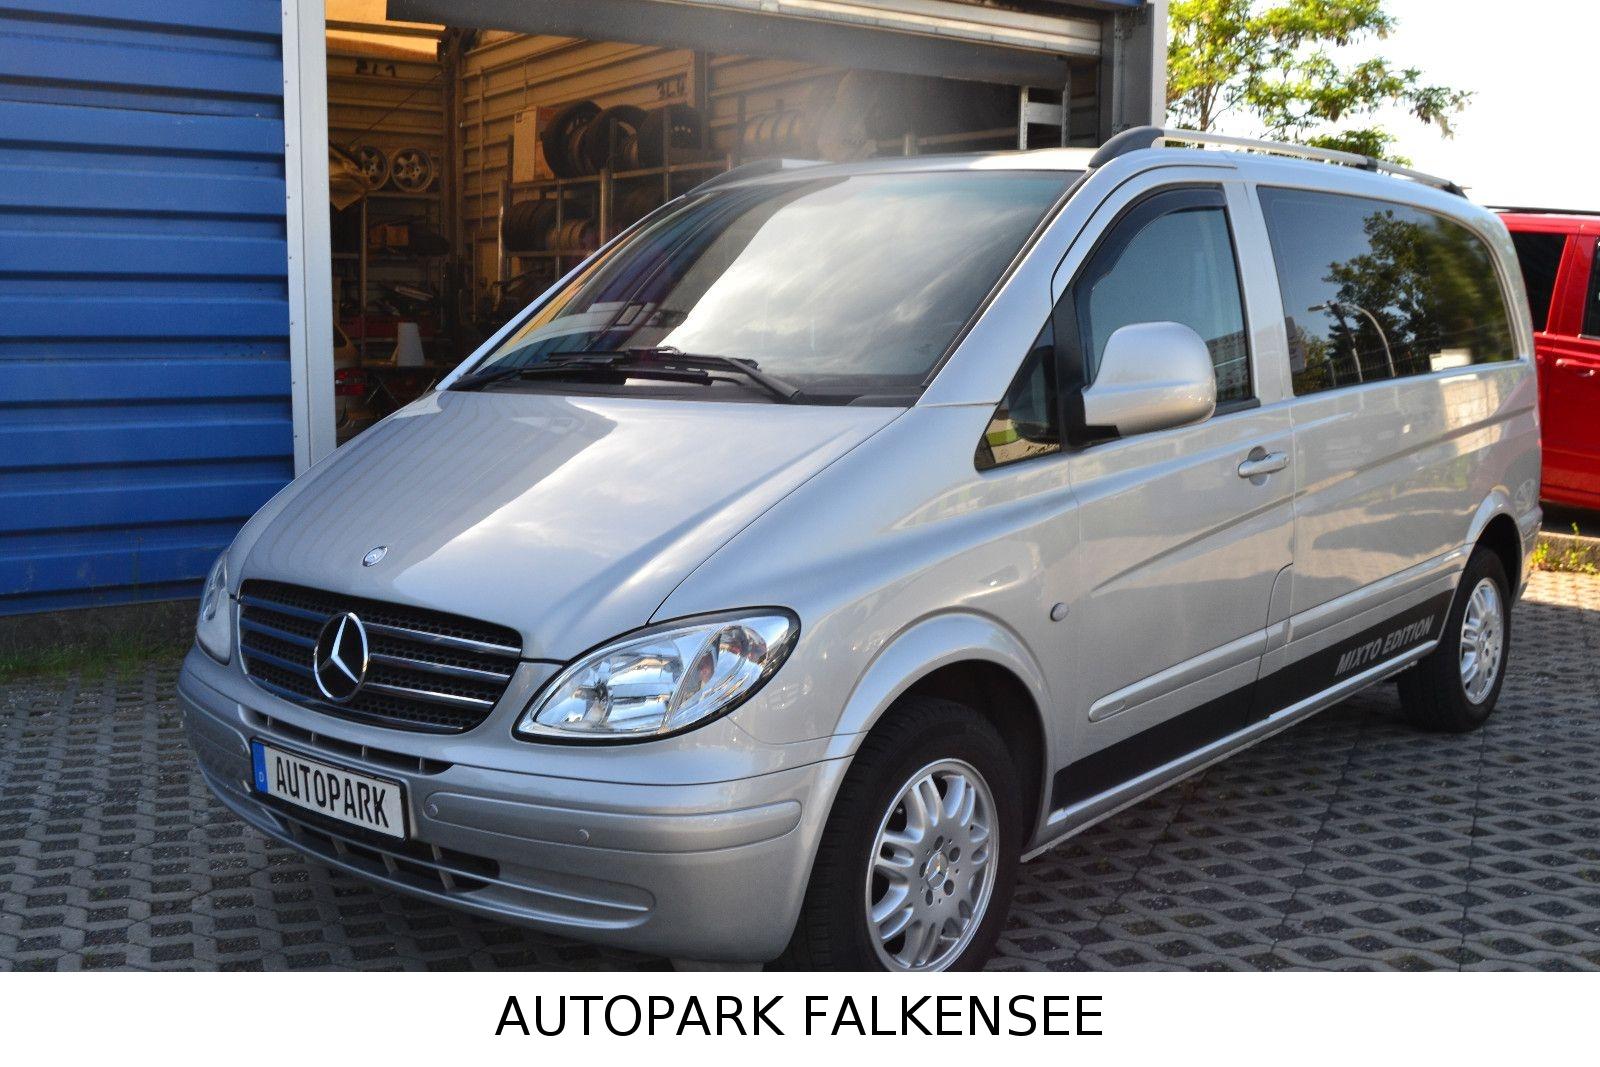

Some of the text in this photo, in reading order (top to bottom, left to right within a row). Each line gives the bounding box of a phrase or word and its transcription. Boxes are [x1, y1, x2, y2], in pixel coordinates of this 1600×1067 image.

[1335, 614, 1435, 676] MIXTO EDITION
[276, 756, 389, 828] AUTOPARK
